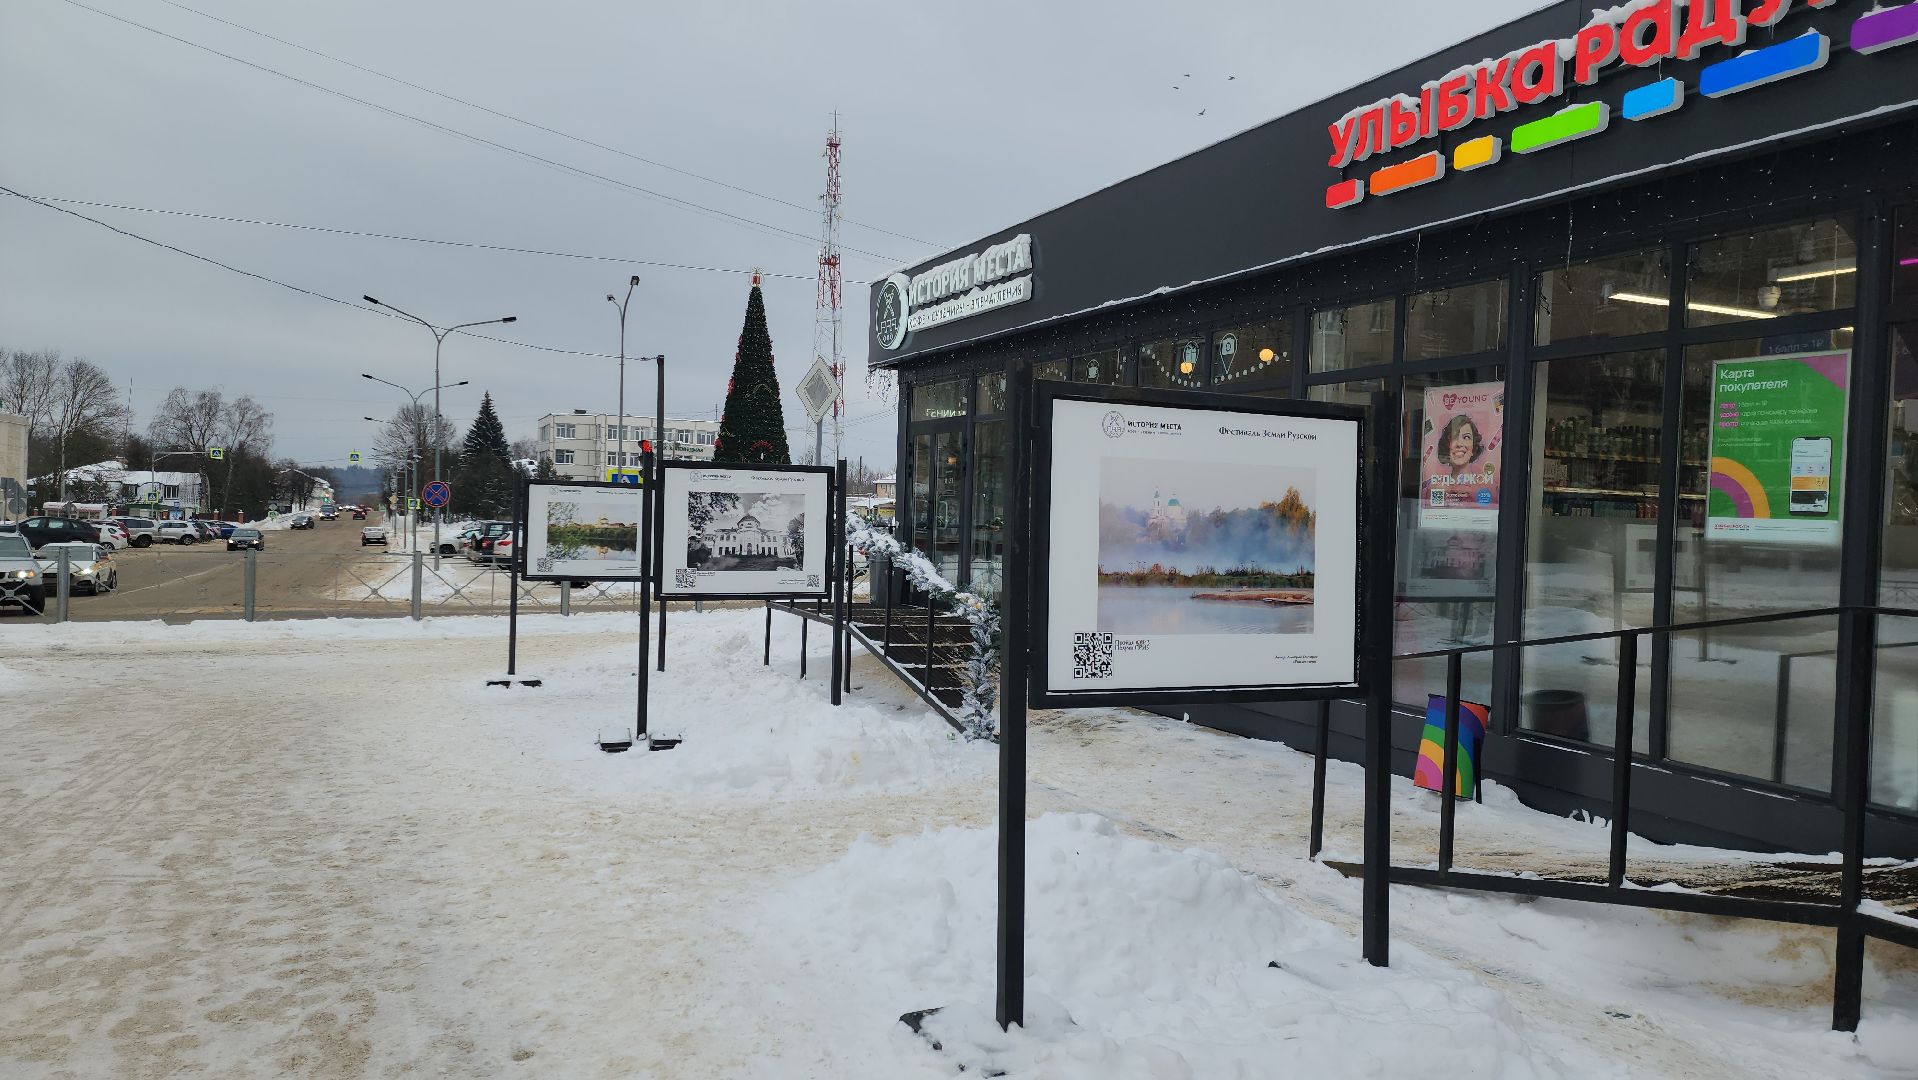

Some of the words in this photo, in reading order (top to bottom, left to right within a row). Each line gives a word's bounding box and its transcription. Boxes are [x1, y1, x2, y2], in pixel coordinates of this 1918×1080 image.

[908, 265, 971, 307] ИСТОРИЯ
[973, 242, 1026, 284] МЕСТА
[1720, 369, 1755, 381] Карта
[1719, 379, 1789, 394] покупателя
[1457, 394, 1489, 404] YOUNG
